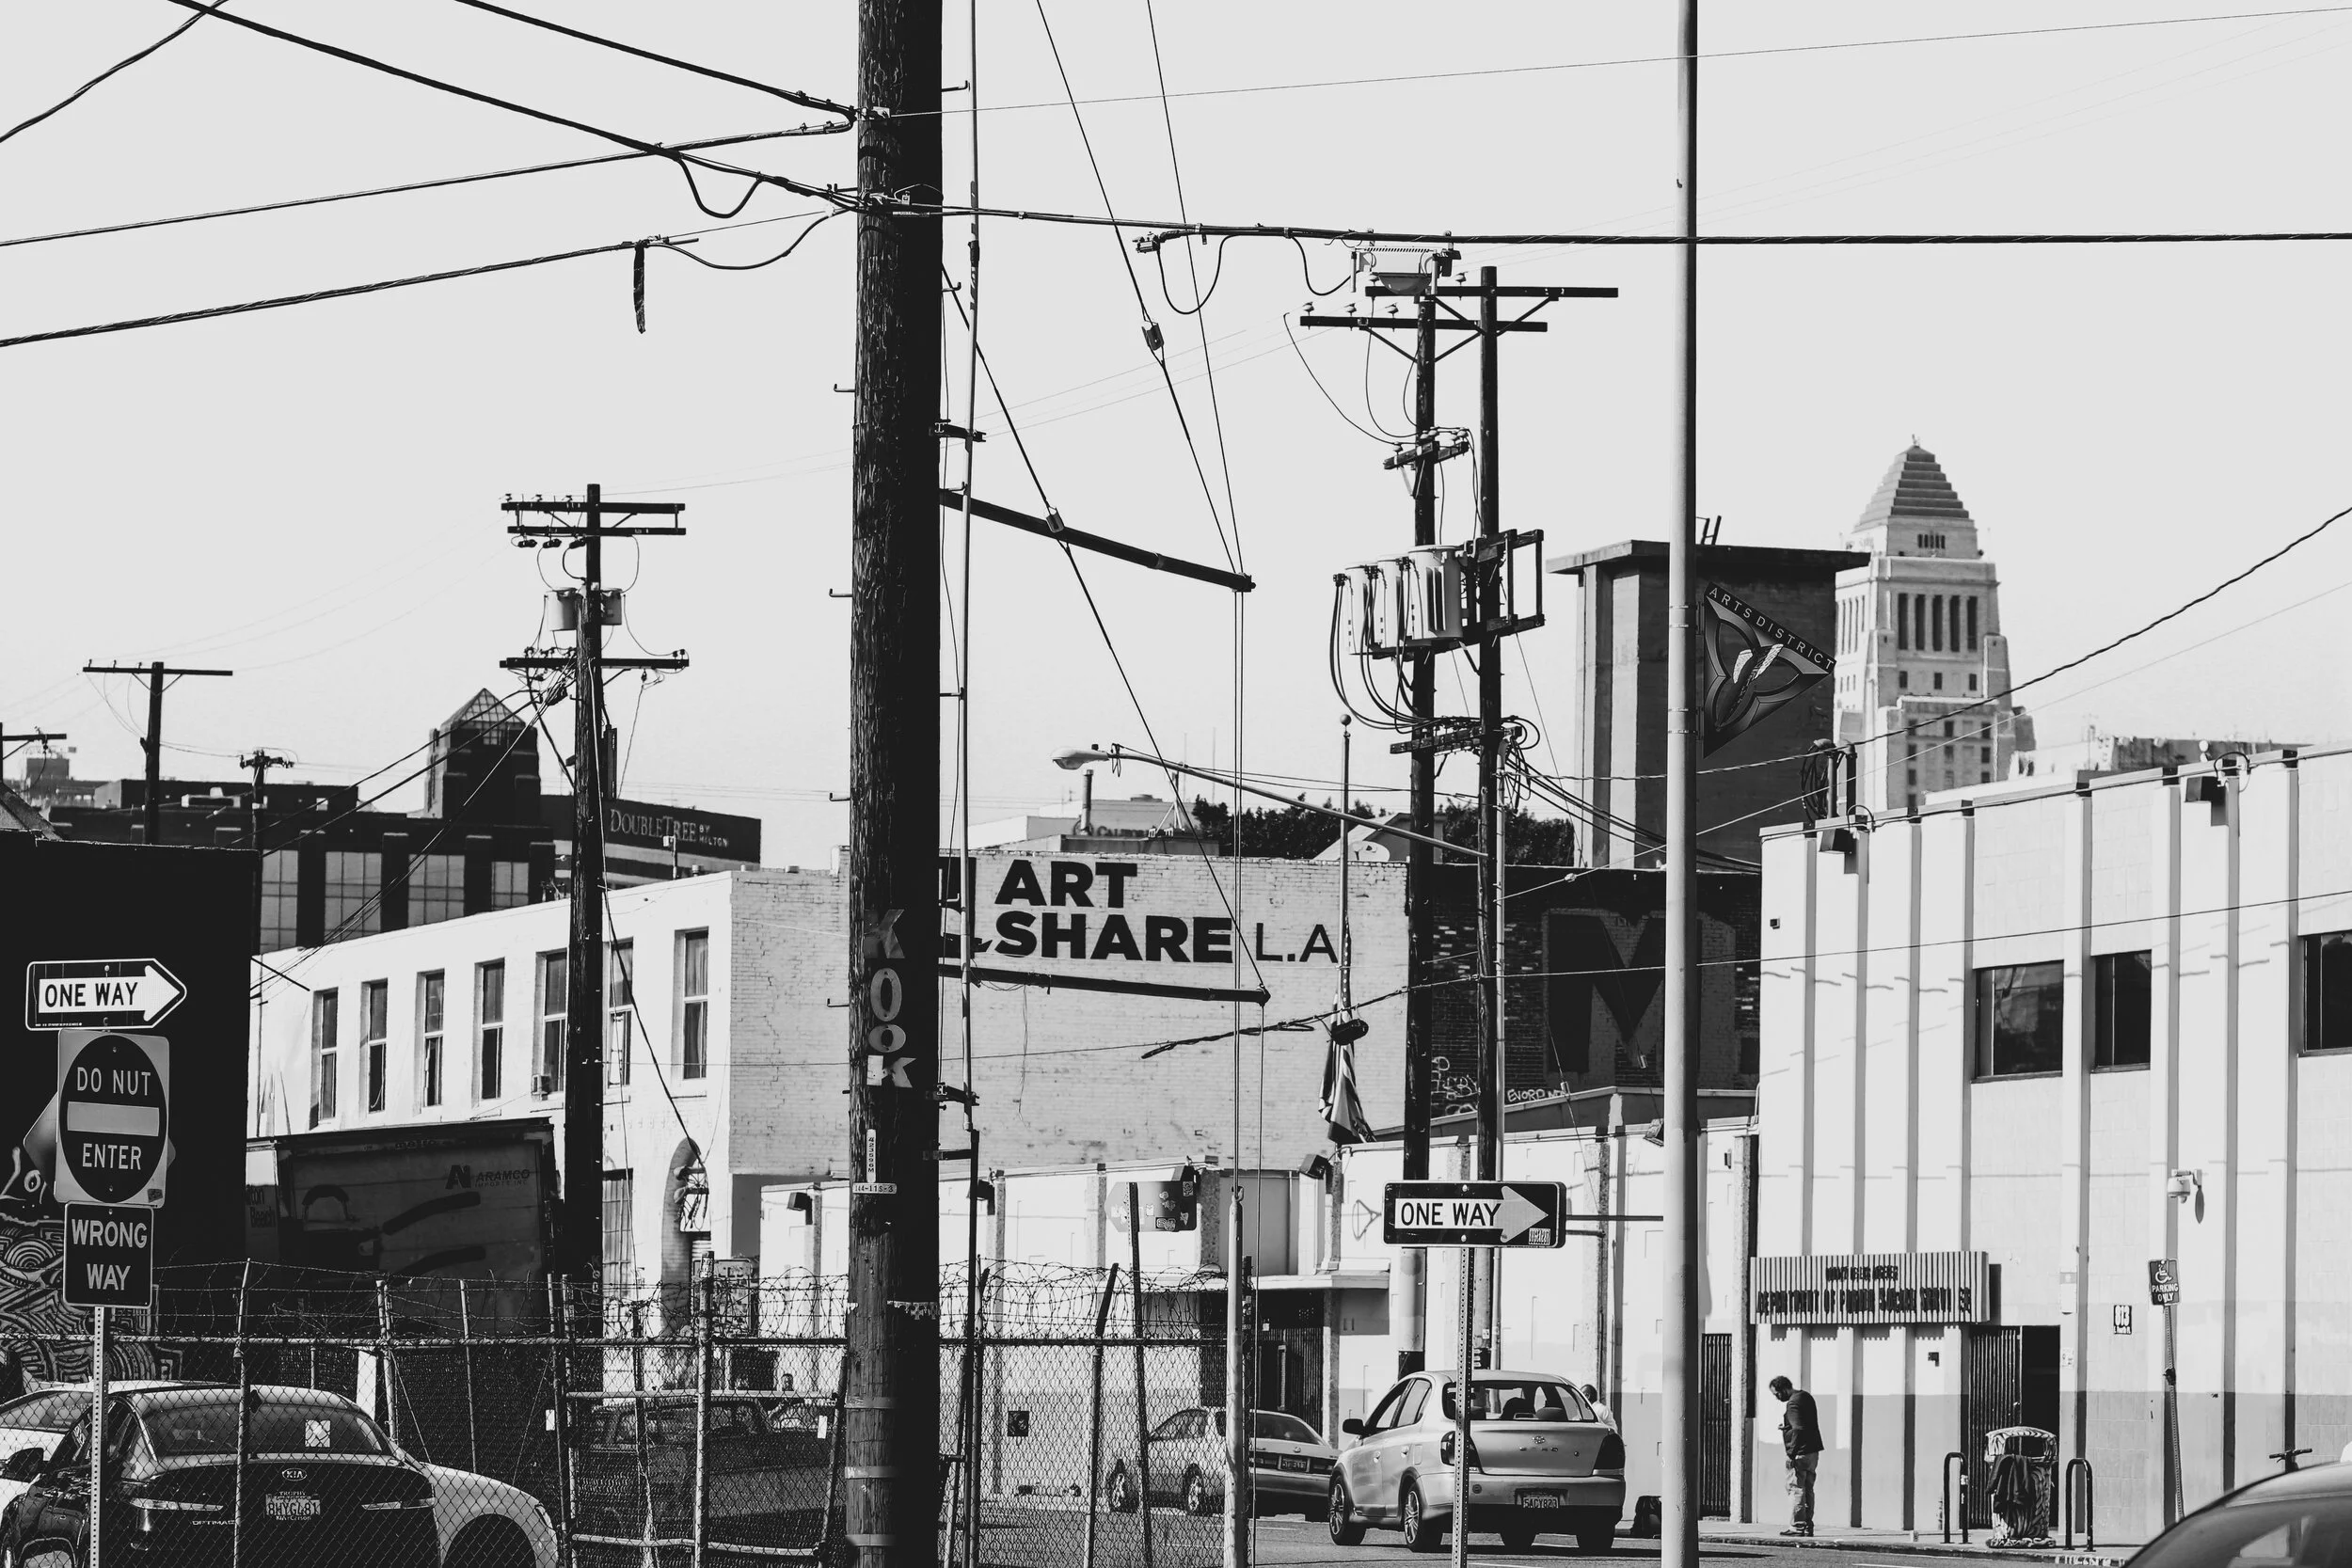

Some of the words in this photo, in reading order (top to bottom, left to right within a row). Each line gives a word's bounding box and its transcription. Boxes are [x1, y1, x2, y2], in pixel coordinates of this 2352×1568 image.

[1709, 587, 1753, 618] ARTS
[1756, 615, 1835, 670] DISTRICT
[994, 859, 1137, 909] ART
[994, 910, 1233, 964] SHARE
[44, 984, 87, 1007] ONE
[95, 981, 138, 1006] WAY
[76, 1067, 102, 1093] DO
[113, 1069, 151, 1096] NUT
[82, 1143, 142, 1170] ENTER
[475, 1168, 531, 1182] ARAMCO
[1401, 1202, 1444, 1226] ONE
[1452, 1203, 1502, 1226] WAY
[72, 1218, 148, 1248] WRONG
[87, 1263, 131, 1291] WAY
[2152, 1283, 2179, 1292] PARKING
